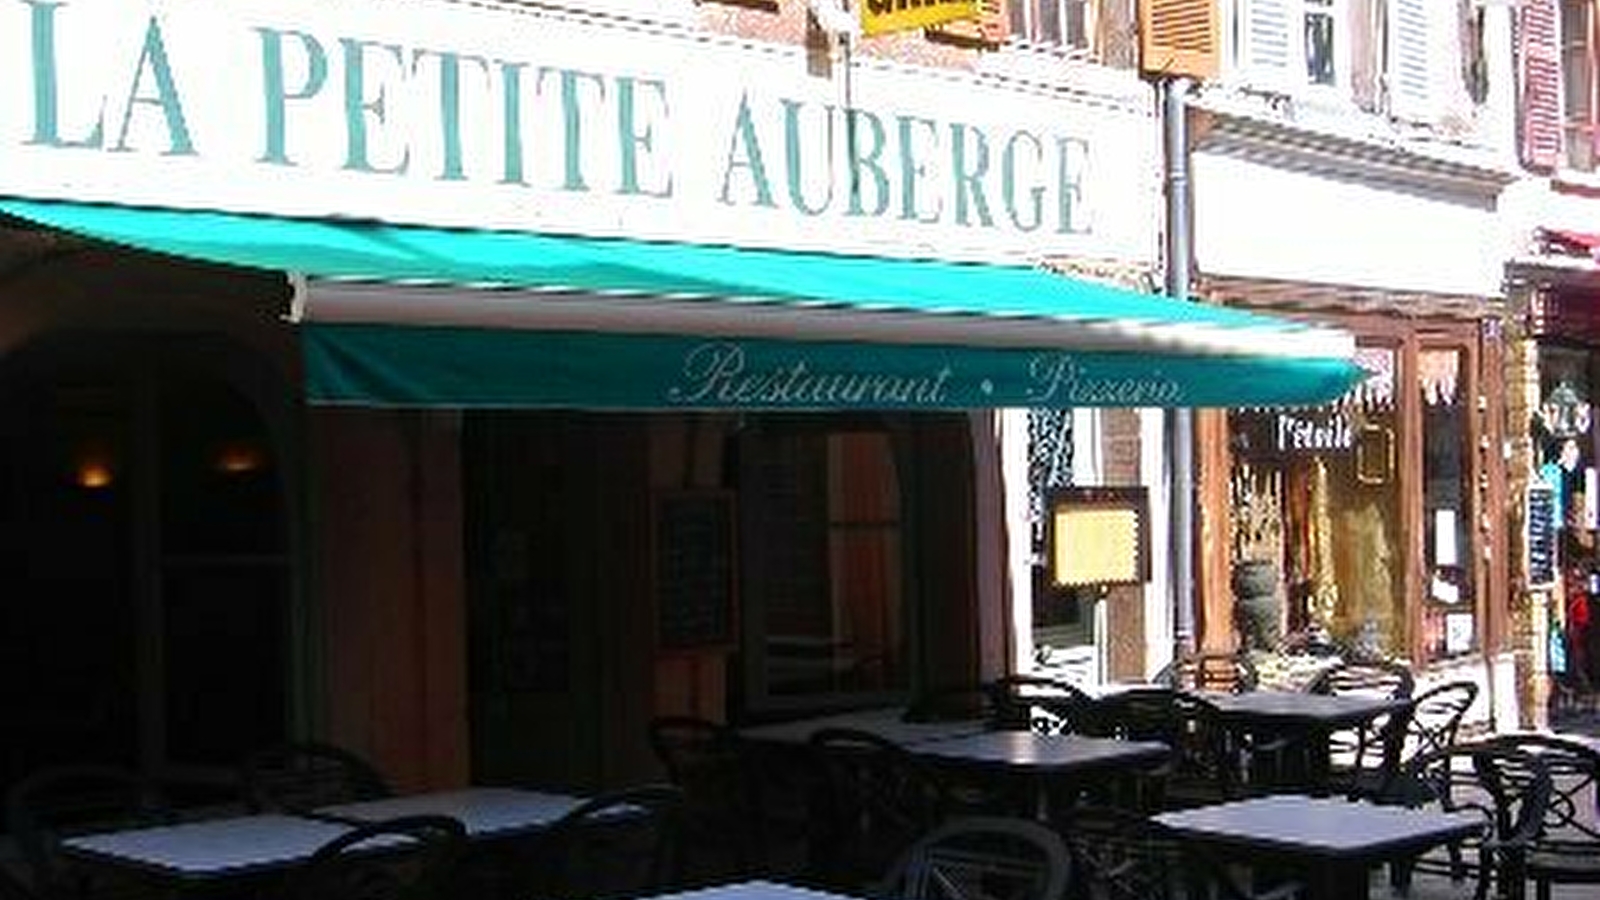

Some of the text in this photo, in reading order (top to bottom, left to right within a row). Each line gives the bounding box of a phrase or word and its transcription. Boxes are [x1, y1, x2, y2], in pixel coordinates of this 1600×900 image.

[20, 0, 1093, 235] LA PETITE AUBERGE
[669, 343, 1184, 404] Restaurant Pizzeria
